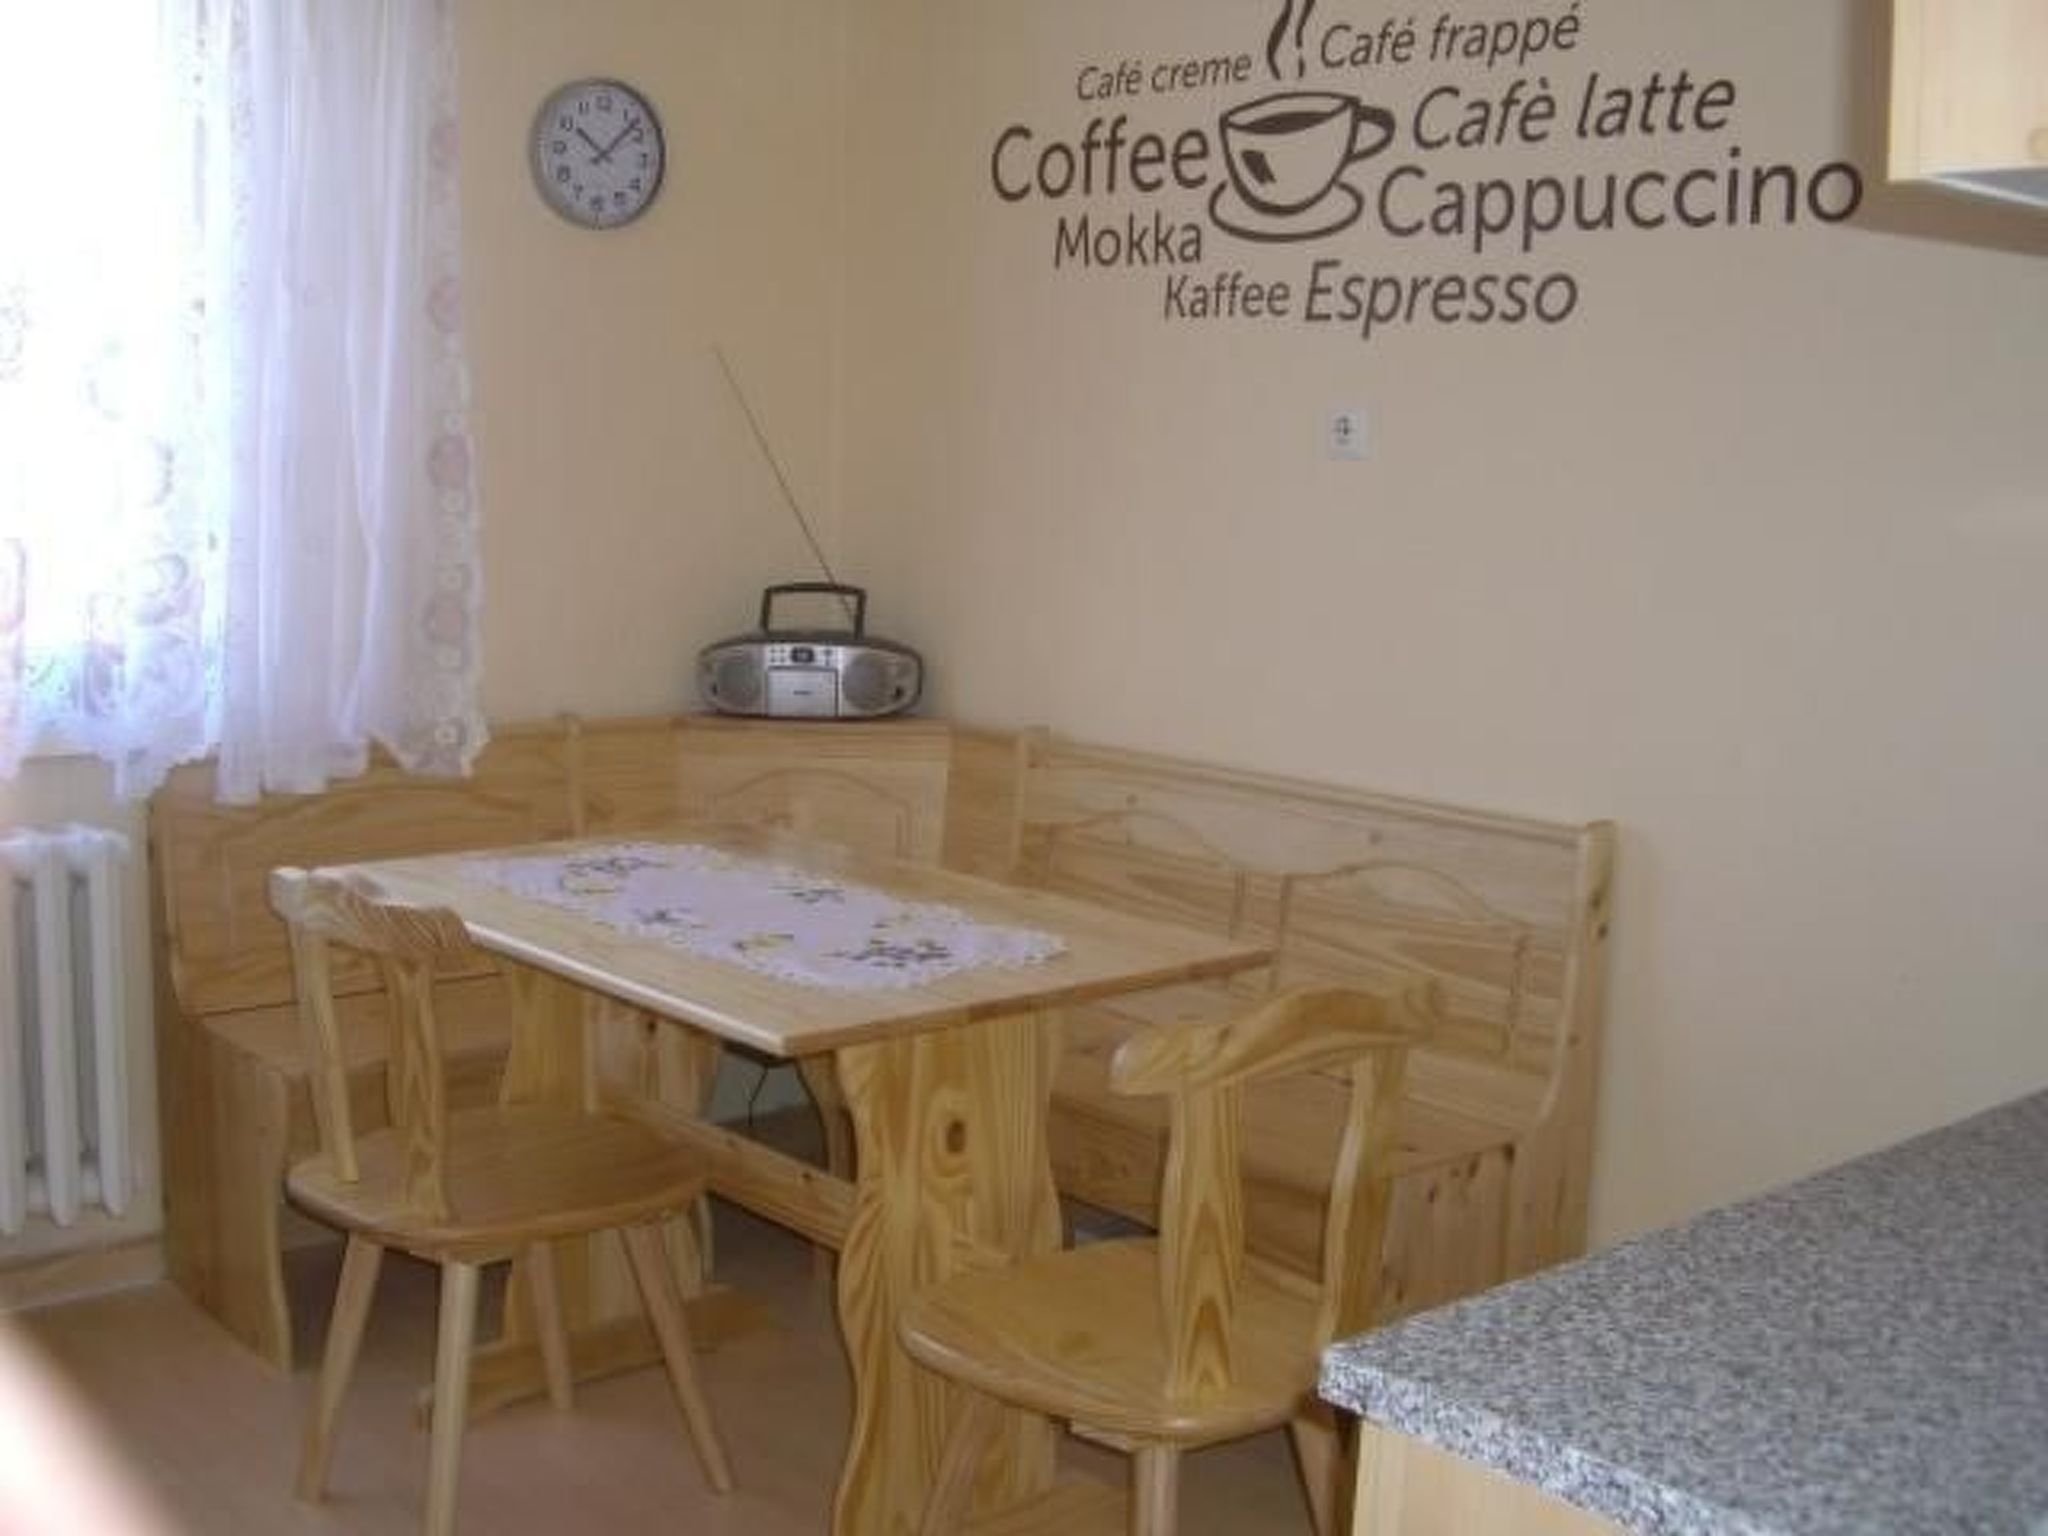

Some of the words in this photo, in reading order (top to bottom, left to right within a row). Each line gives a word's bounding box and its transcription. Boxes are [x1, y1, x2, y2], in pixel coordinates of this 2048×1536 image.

[1319, 17, 1417, 68] Café
[1428, 2, 1580, 66] frappé
[1077, 60, 1143, 101] Café
[1150, 53, 1252, 90] creme
[1412, 76, 1556, 151] Cafè
[1574, 70, 1737, 140] latte
[990, 114, 1210, 203] Coffee
[1054, 210, 1202, 270] Mokka
[1377, 146, 1864, 254] Cappuccino
[1164, 271, 1291, 321] Kaffee
[1304, 259, 1578, 341] Espresso
